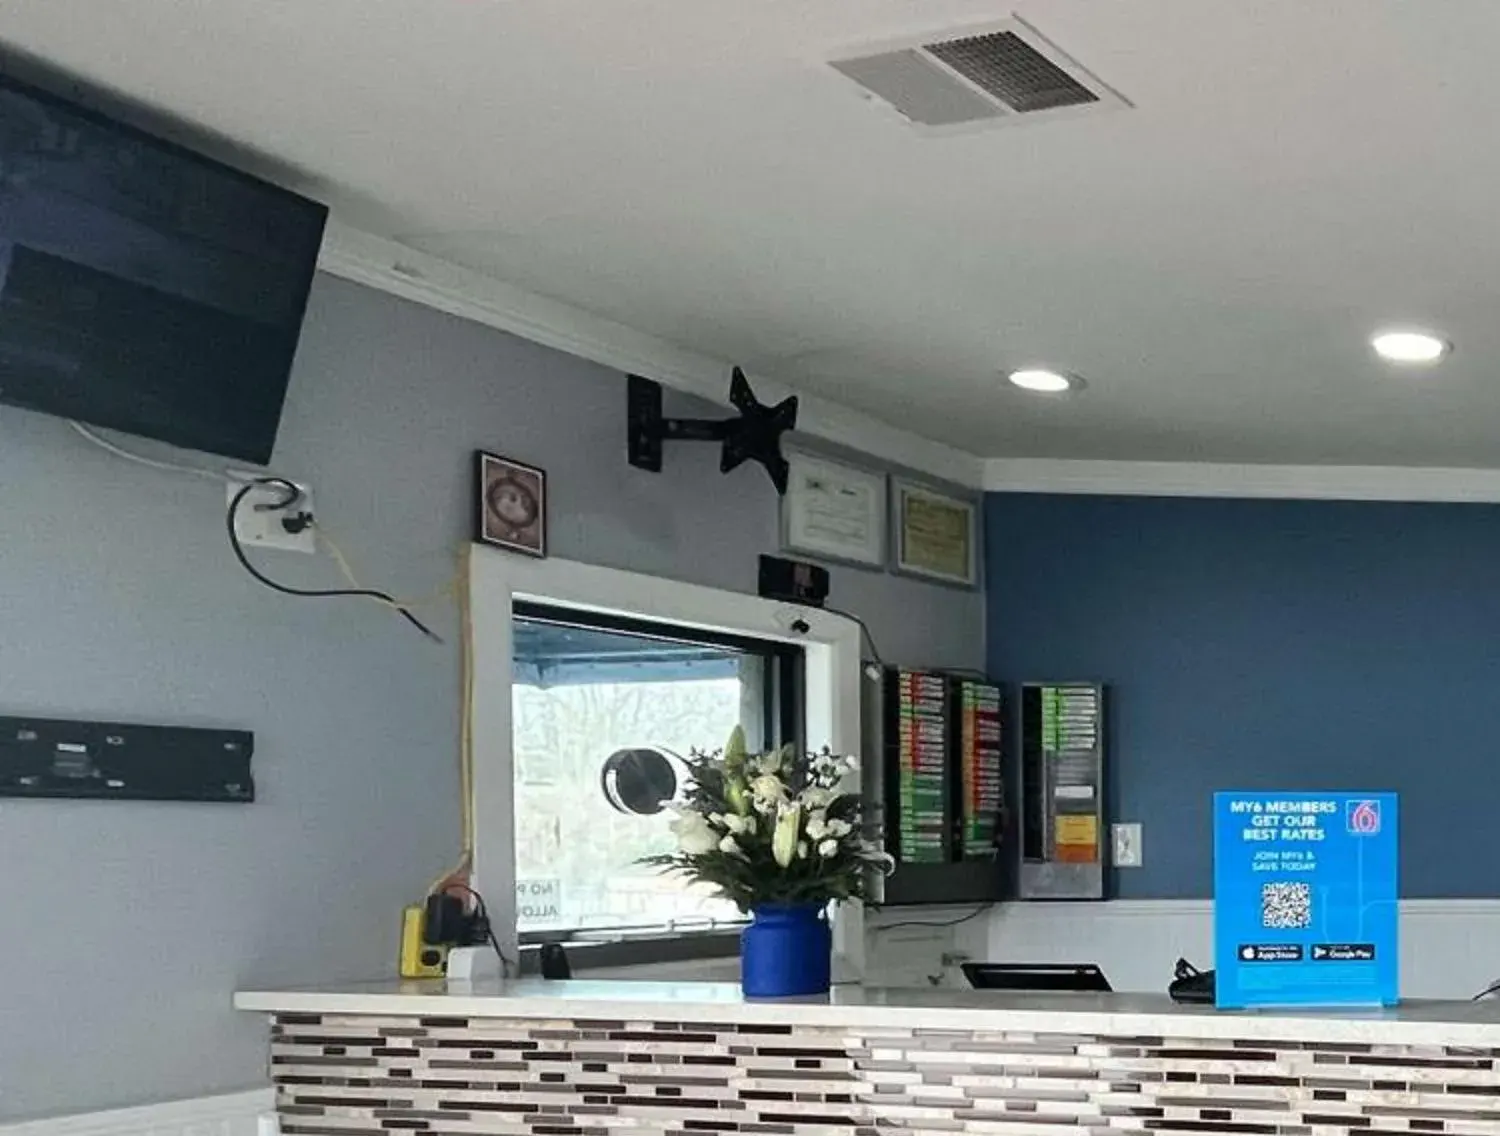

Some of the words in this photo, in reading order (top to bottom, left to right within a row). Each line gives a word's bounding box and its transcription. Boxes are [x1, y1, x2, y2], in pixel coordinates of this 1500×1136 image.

[1230, 801, 1263, 813] MY6
[1265, 801, 1337, 813] MEMBERS
[1251, 815, 1280, 826] GET
[1284, 815, 1317, 827] OUR
[1243, 829, 1279, 841] BEST
[1281, 829, 1325, 841] RATES
[1254, 851, 1279, 860] JOIN
[1252, 862, 1278, 871] SAVE
[1281, 862, 1317, 871] TODAY
